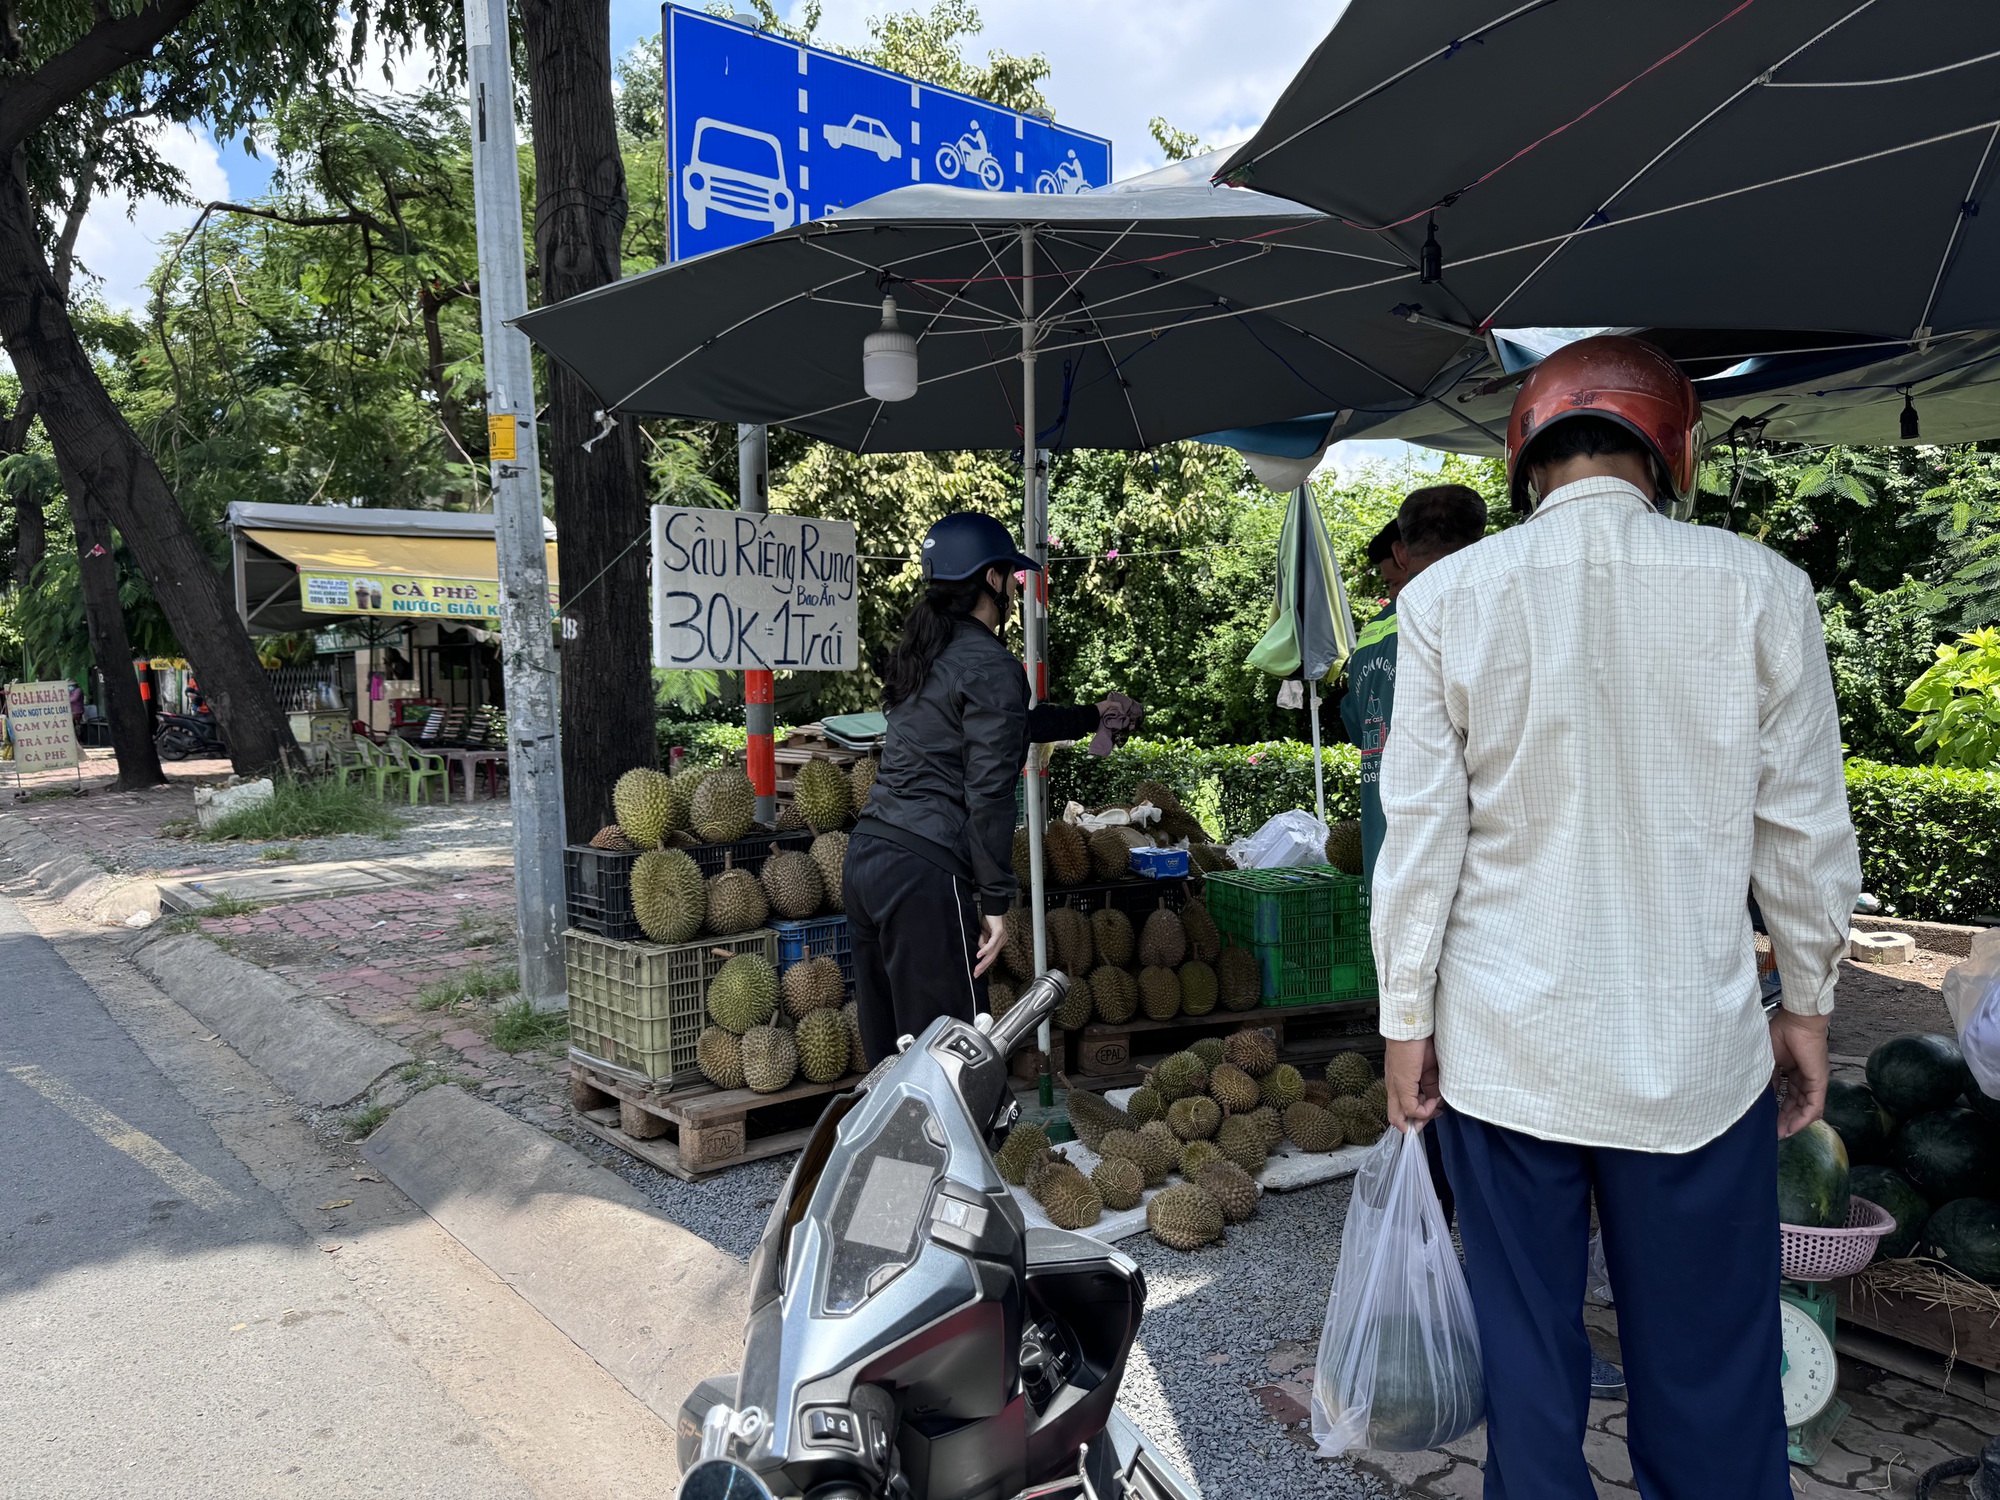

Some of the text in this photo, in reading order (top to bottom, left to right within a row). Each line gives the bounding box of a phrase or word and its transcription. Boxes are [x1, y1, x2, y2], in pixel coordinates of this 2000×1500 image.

[663, 512, 727, 577] Sầu
[391, 581, 424, 597] CÀ
[432, 584, 478, 600] PHÊ
[796, 585, 818, 607] Bao
[392, 600, 442, 614] NƯỚC
[14, 721, 40, 732] CAM
[17, 735, 42, 748] TRÀ
[24, 748, 67, 762] CÀ PHÊ
[1100, 1048, 1123, 1062] EPAL
[1808, 1369, 1816, 1380] 3
